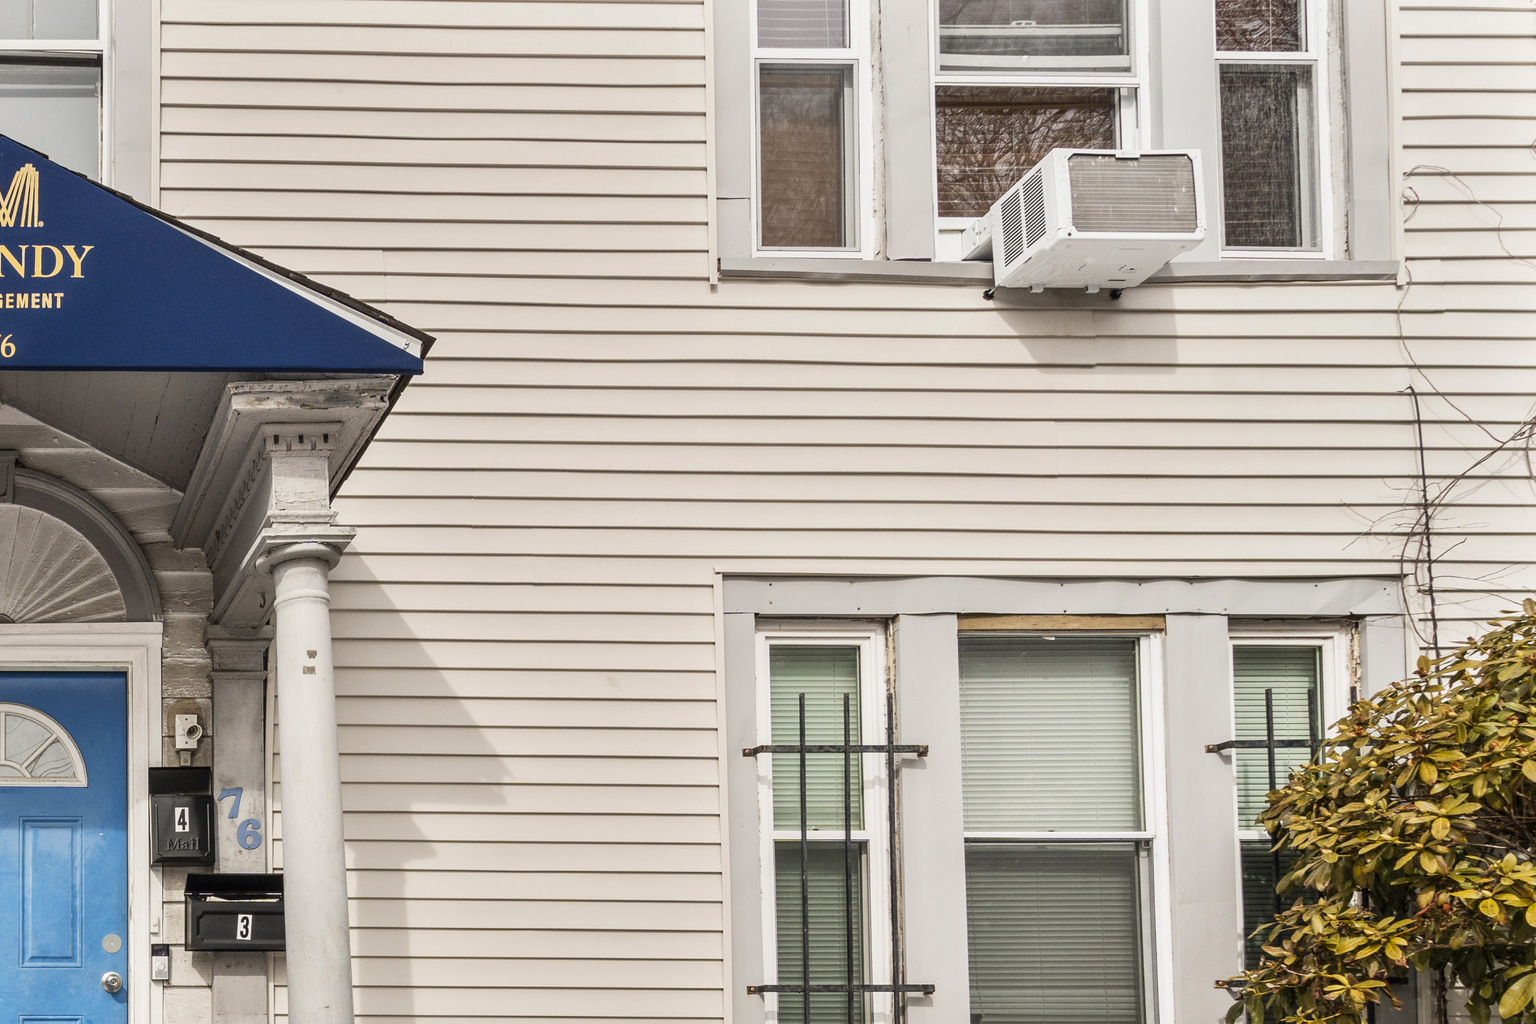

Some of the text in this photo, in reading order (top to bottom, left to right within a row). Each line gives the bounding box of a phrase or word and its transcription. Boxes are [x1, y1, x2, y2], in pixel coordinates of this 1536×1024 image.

[178, 809, 187, 830] 4
[166, 837, 201, 851] Mail
[240, 916, 249, 938] 3
